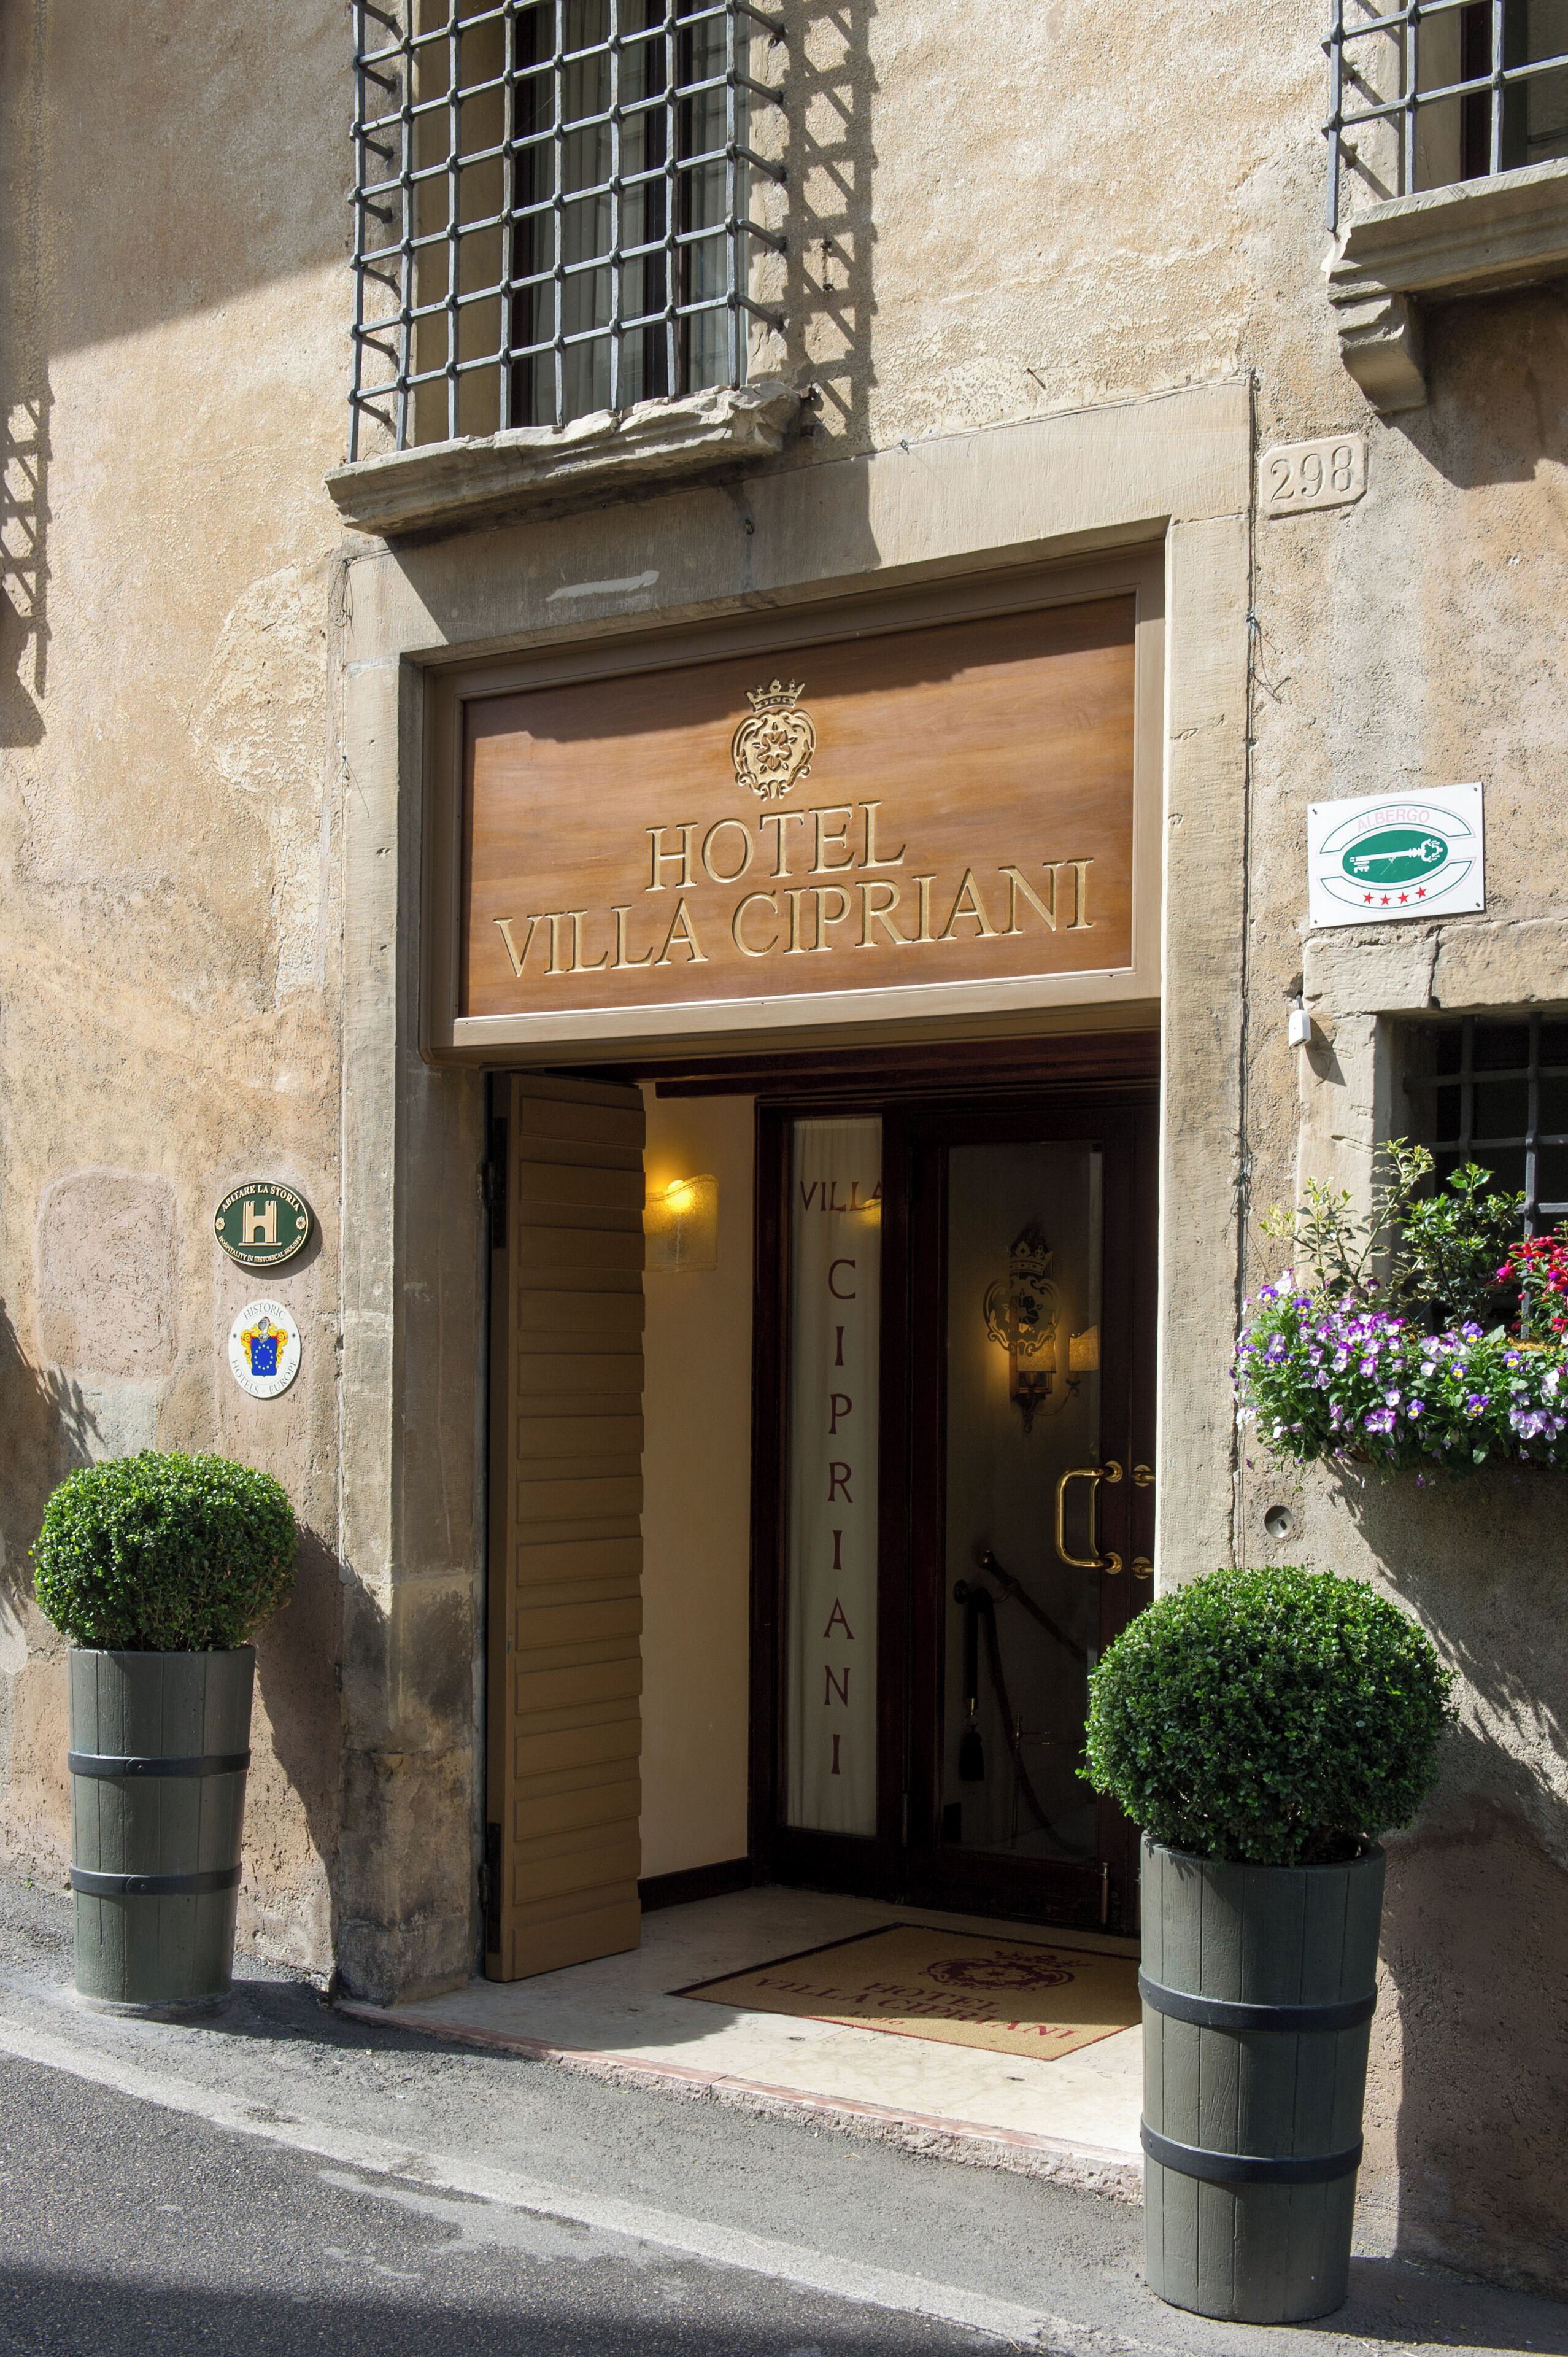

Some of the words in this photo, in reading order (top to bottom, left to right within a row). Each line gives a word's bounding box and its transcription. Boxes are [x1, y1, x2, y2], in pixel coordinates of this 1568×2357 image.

[1270, 446, 1353, 503] 298
[1357, 808, 1431, 833] ALBERGO
[646, 800, 906, 892] HOTEL
[493, 896, 709, 977] VILLA
[732, 857, 1095, 958] CIPRIANI
[222, 1185, 256, 1212] ABITARE
[258, 1185, 269, 1193] LA
[270, 1185, 301, 1212] STORIA
[218, 1235, 247, 1260] HOSPITALITY
[254, 1250, 284, 1263] HISTORICAL
[284, 1234, 302, 1255] HOUSES
[243, 1302, 286, 1320] HISTORIC
[231, 1359, 259, 1395] HOTELS
[269, 1358, 298, 1395] EUROPE
[822, 1258, 857, 1776] CIPRIANI
[755, 1978, 864, 2005] VILLA
[876, 1998, 1081, 2040] CIPRIANI
[862, 1982, 1002, 2013] HOTEL
